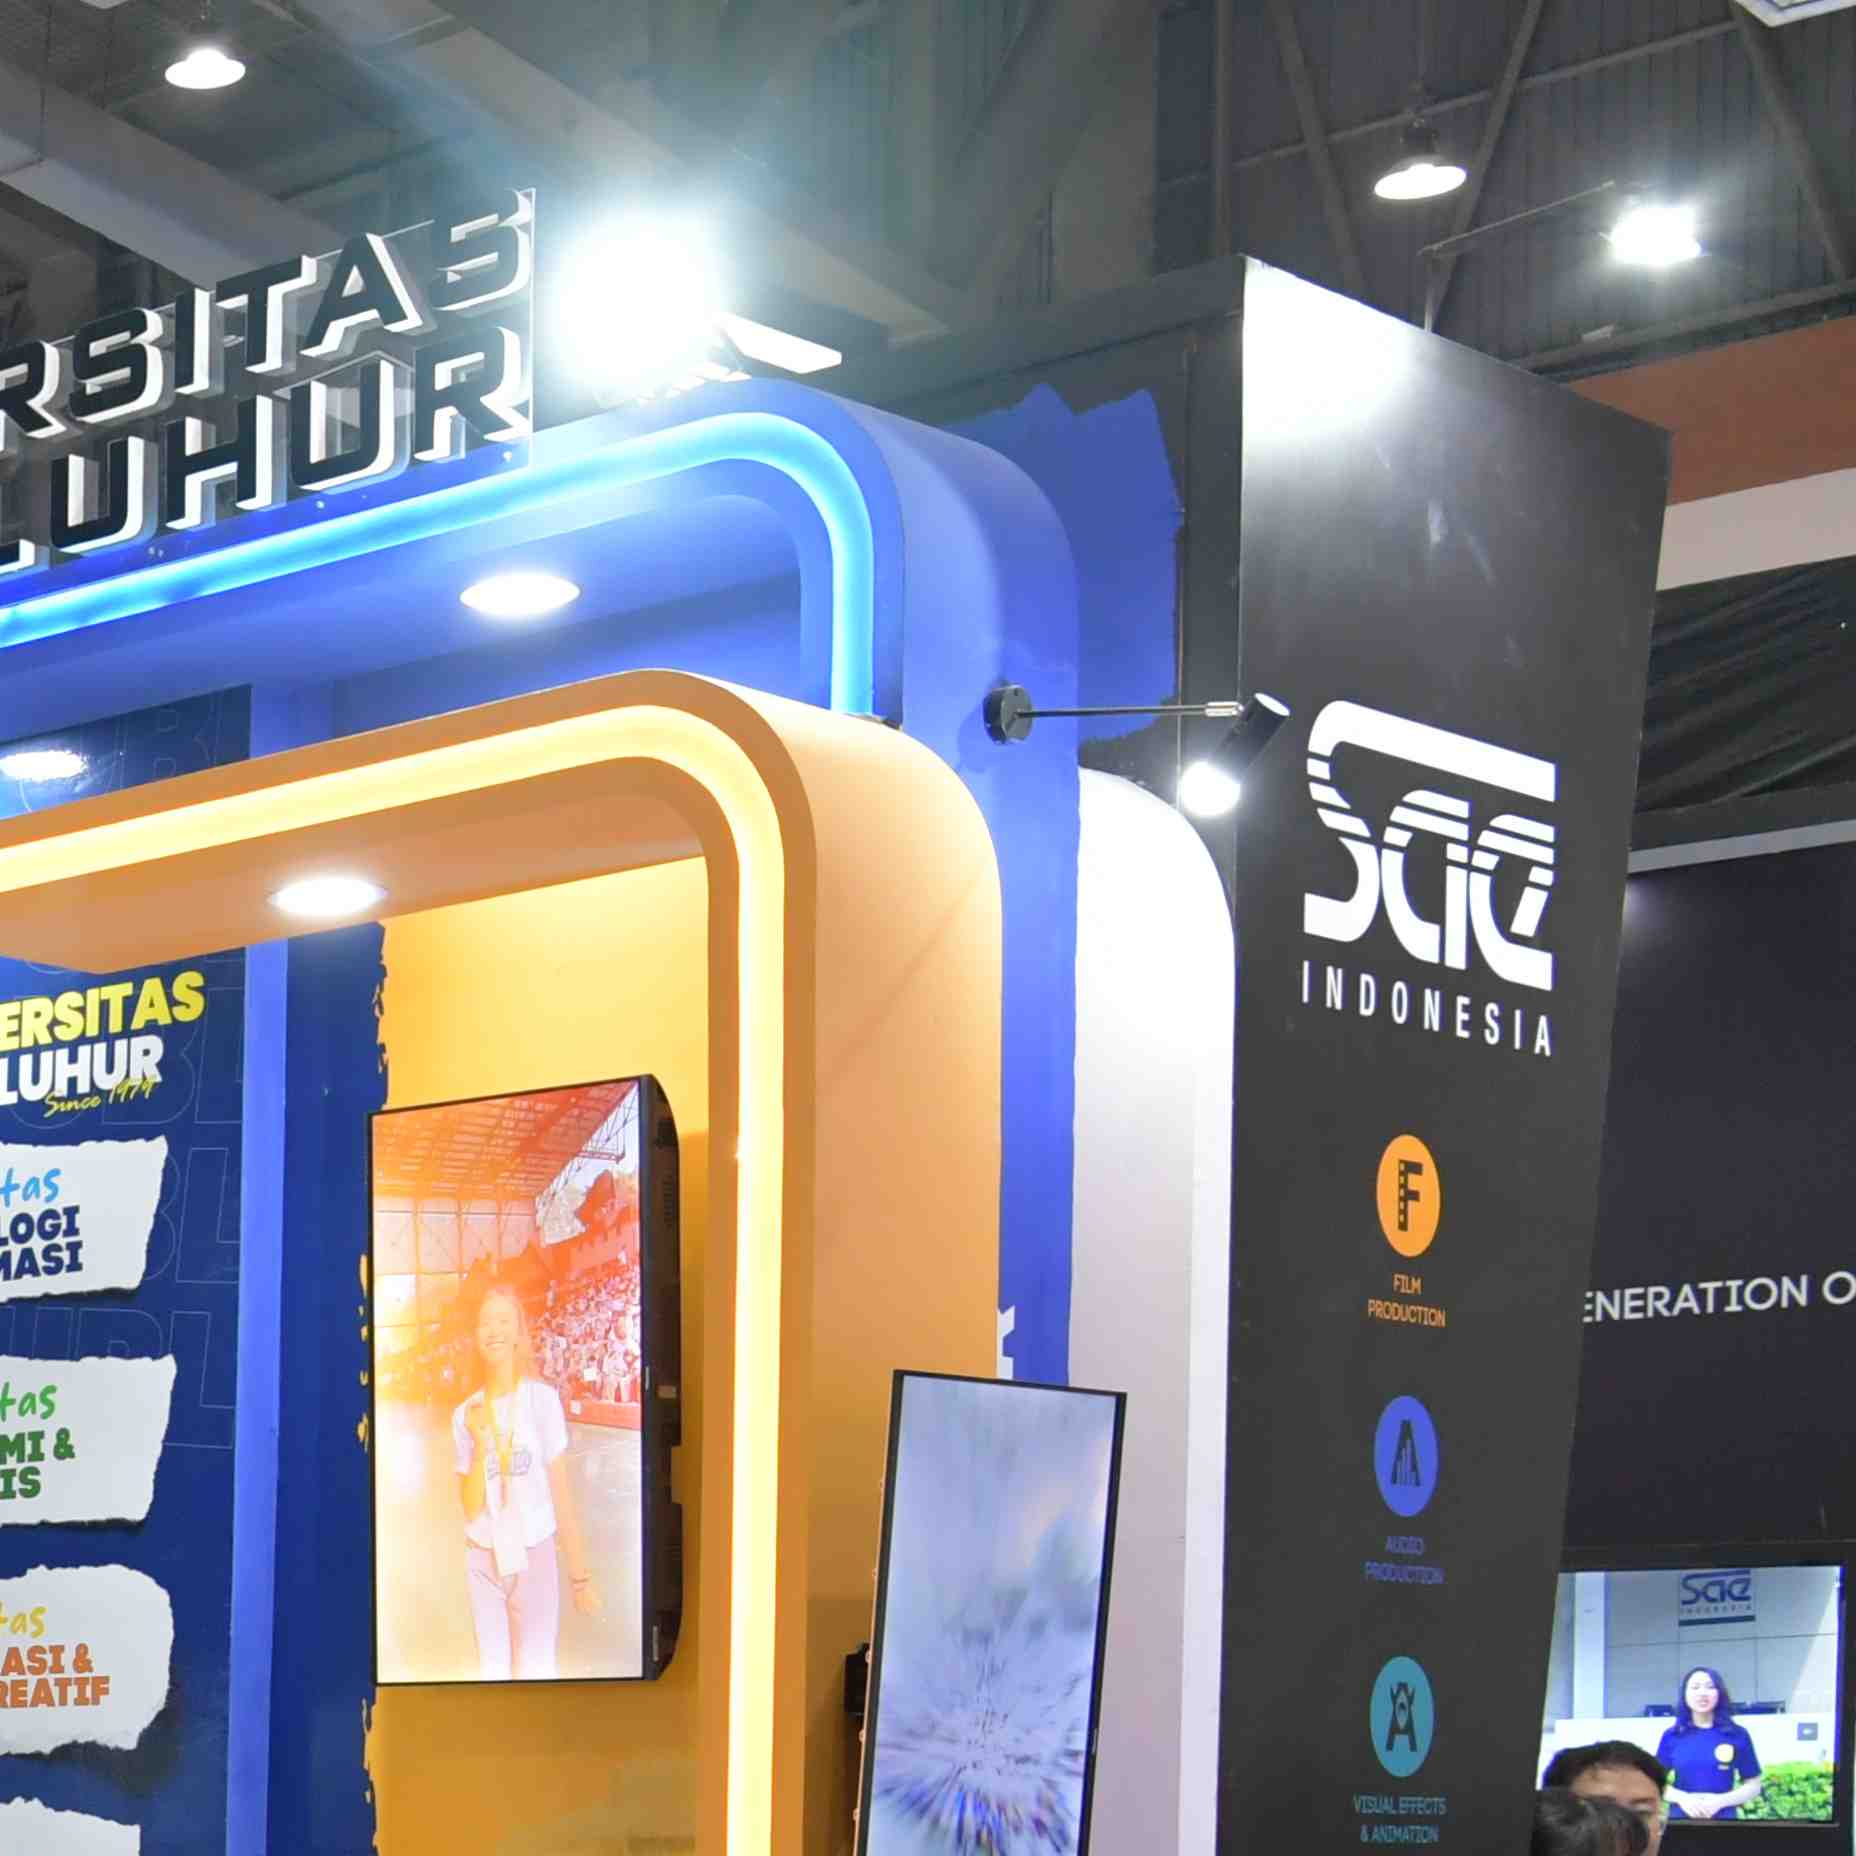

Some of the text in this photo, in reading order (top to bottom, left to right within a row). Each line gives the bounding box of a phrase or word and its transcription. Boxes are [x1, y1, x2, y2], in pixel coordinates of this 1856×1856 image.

[1301, 960, 1552, 1057] INDONESIA
[43, 1074, 158, 1118] Since 1979
[1392, 1273, 1422, 1296] FILM
[1367, 1298, 1446, 1328] PRODUCTION
[53, 1427, 76, 1460] &
[1365, 1562, 1445, 1585] PRODUCTION
[72, 1642, 94, 1674] &
[1354, 1794, 1447, 1816] VISUAL EFFECTS
[1372, 1824, 1439, 1844] ANIMATION
